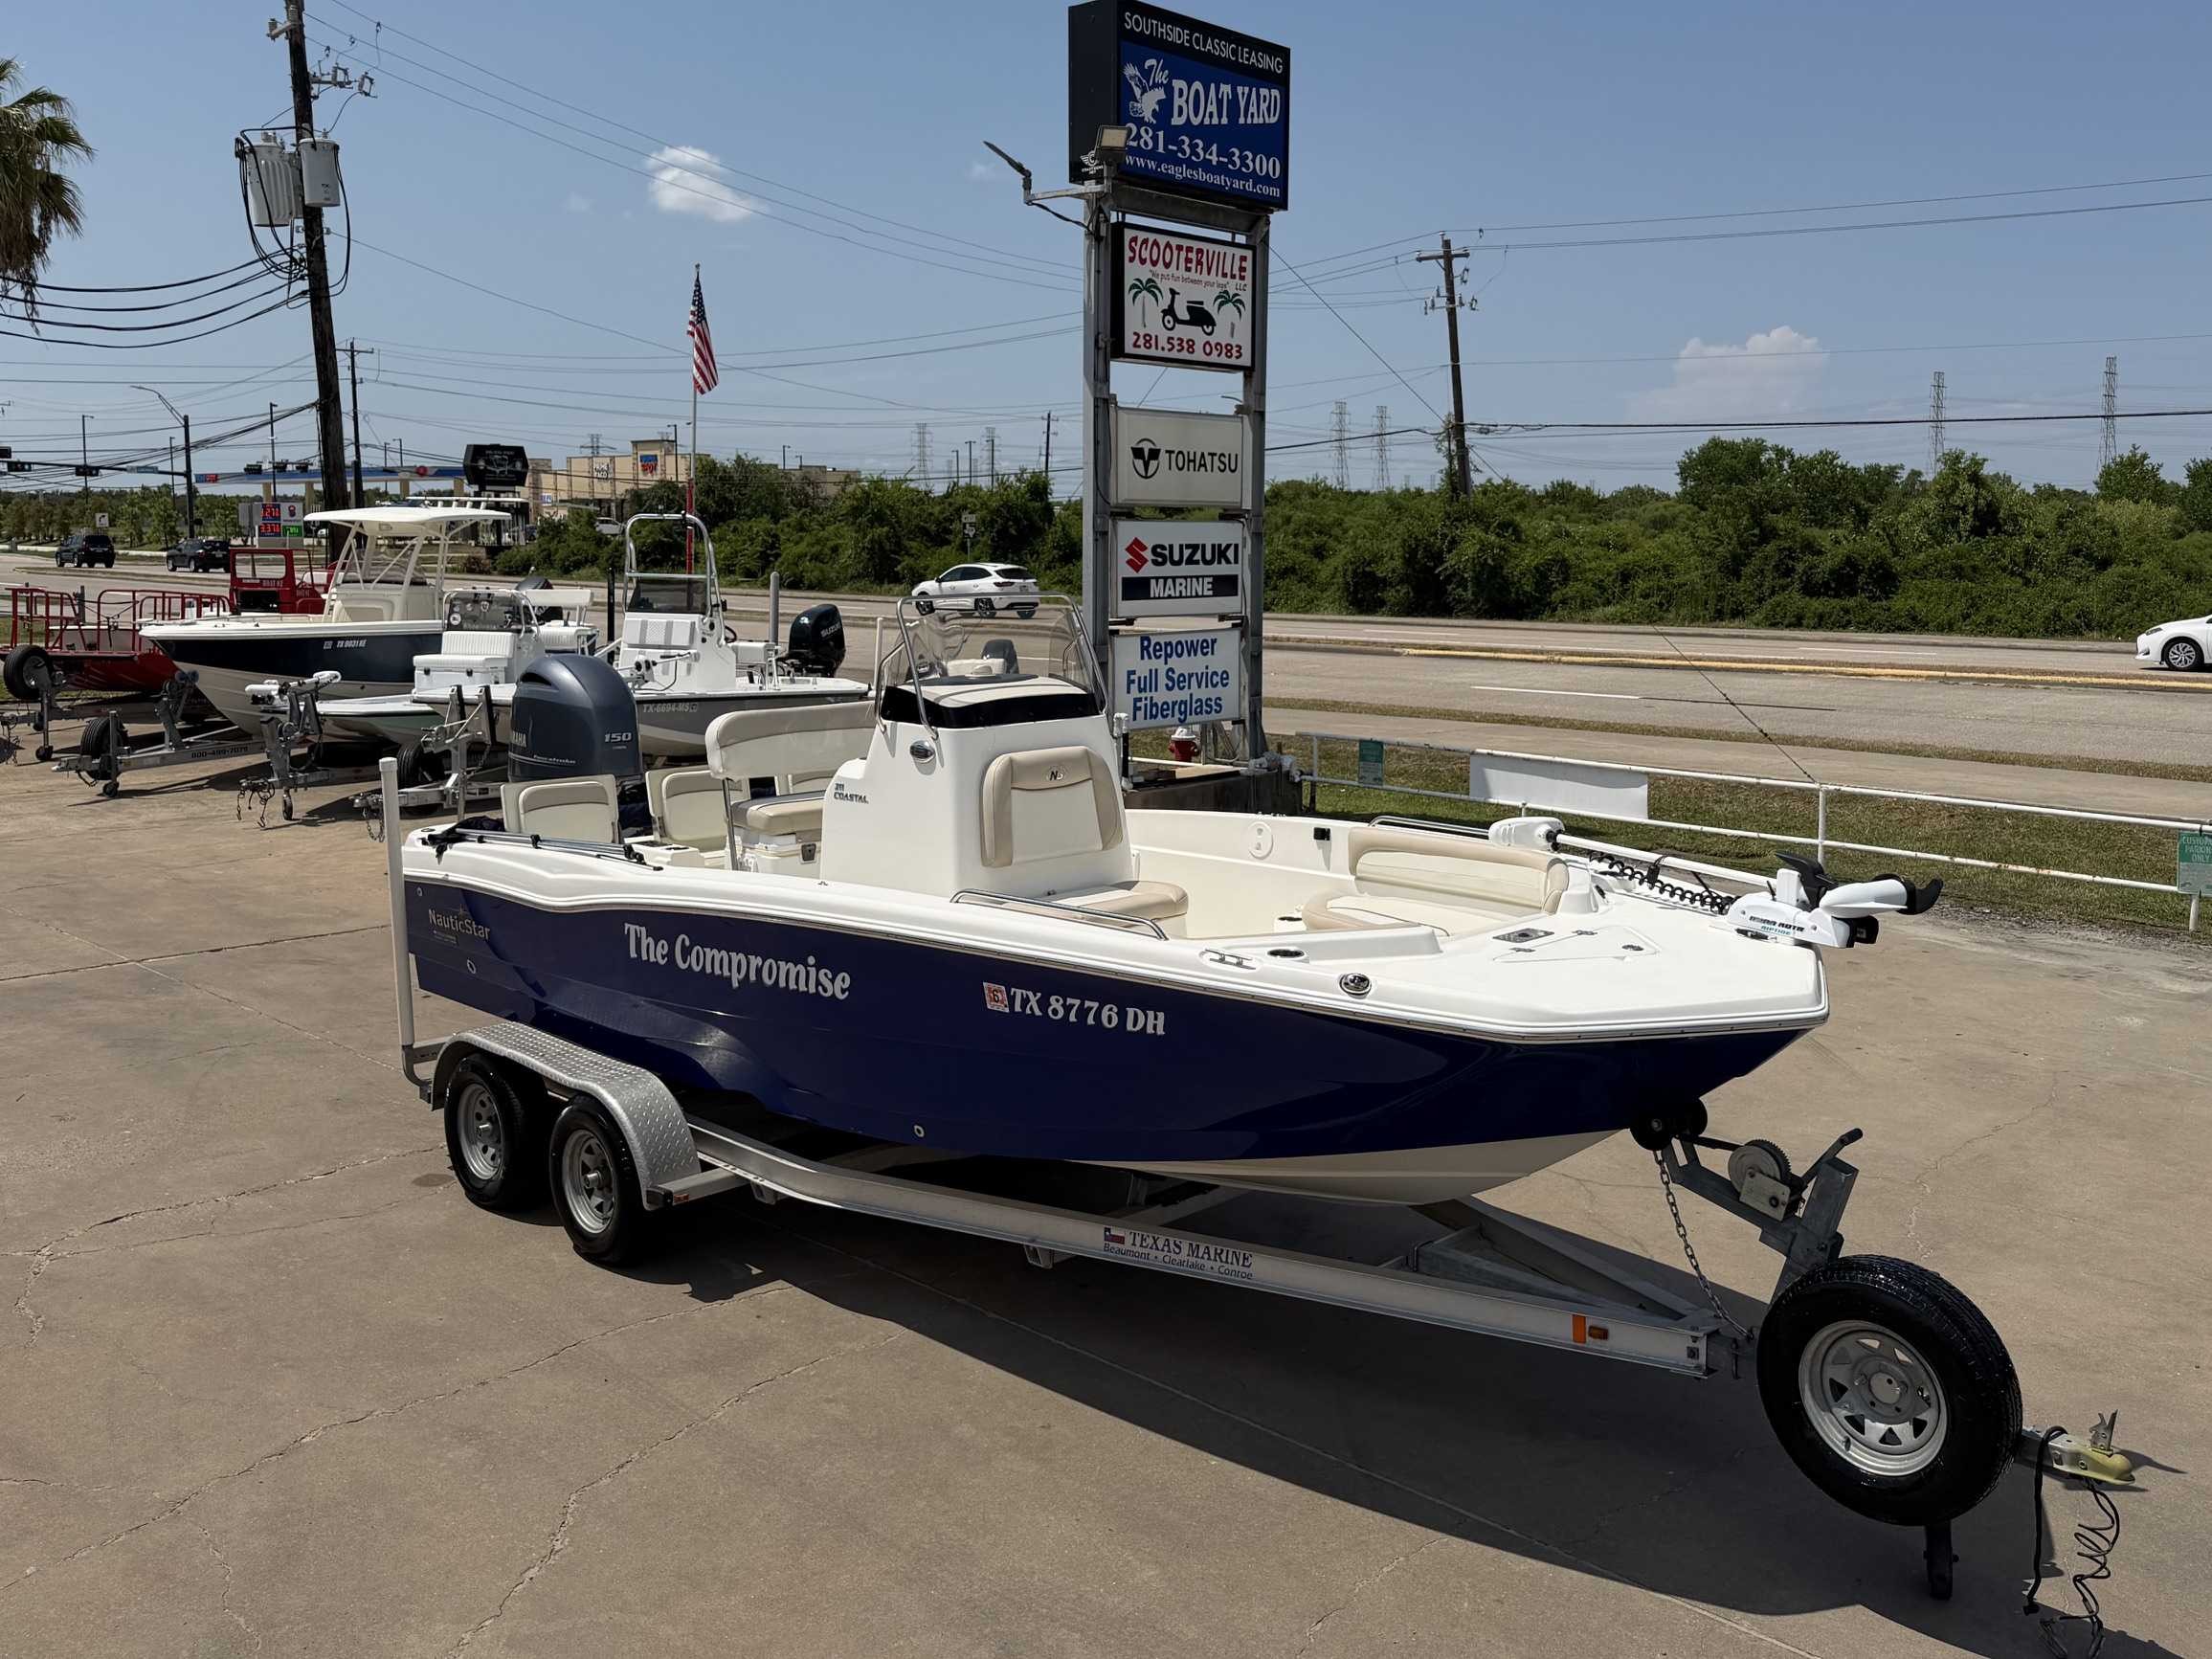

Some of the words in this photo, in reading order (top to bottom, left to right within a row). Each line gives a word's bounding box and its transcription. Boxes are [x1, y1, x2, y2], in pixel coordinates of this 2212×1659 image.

[1125, 11, 1190, 47] SOUTHSIDE
[1192, 33, 1237, 61] CLASSIC
[1238, 46, 1284, 74] LEASING
[1145, 58, 1170, 85] The
[1171, 78, 1232, 126] BOAT
[1237, 85, 1282, 124] YARD
[1125, 123, 1281, 179] 281-334-3300
[1126, 154, 1281, 197] www.eaglesboatyard.com
[1128, 235, 1247, 281] SCOOTERVILLE
[1235, 282, 1247, 292] LLC
[1132, 331, 1195, 354] 281.538
[1202, 340, 1242, 360] 0983
[1165, 449, 1239, 473] TOHATSU
[1151, 543, 1239, 567] SUZUKI
[1150, 576, 1213, 598] MARINE
[1140, 636, 1218, 665] Repower
[1127, 668, 1158, 694] Full
[1165, 665, 1230, 691] Service
[1132, 693, 1223, 724] Fiberglass
[604, 732, 632, 743] 150
[834, 792, 869, 804] COASTAL
[428, 908, 491, 942] NauticStar
[624, 923, 669, 966] The
[674, 933, 851, 1000] Compromise
[1010, 987, 1042, 1016] TX
[1048, 995, 1118, 1028] 8776
[1126, 1007, 1165, 1035] DH
[1103, 1243, 1151, 1261] Beaumont
[1162, 1254, 1206, 1271] Clearlake
[1218, 1265, 1253, 1280] Conroe
[1129, 1231, 1182, 1255] TEXAS
[1187, 1242, 1253, 1268] MARINE
